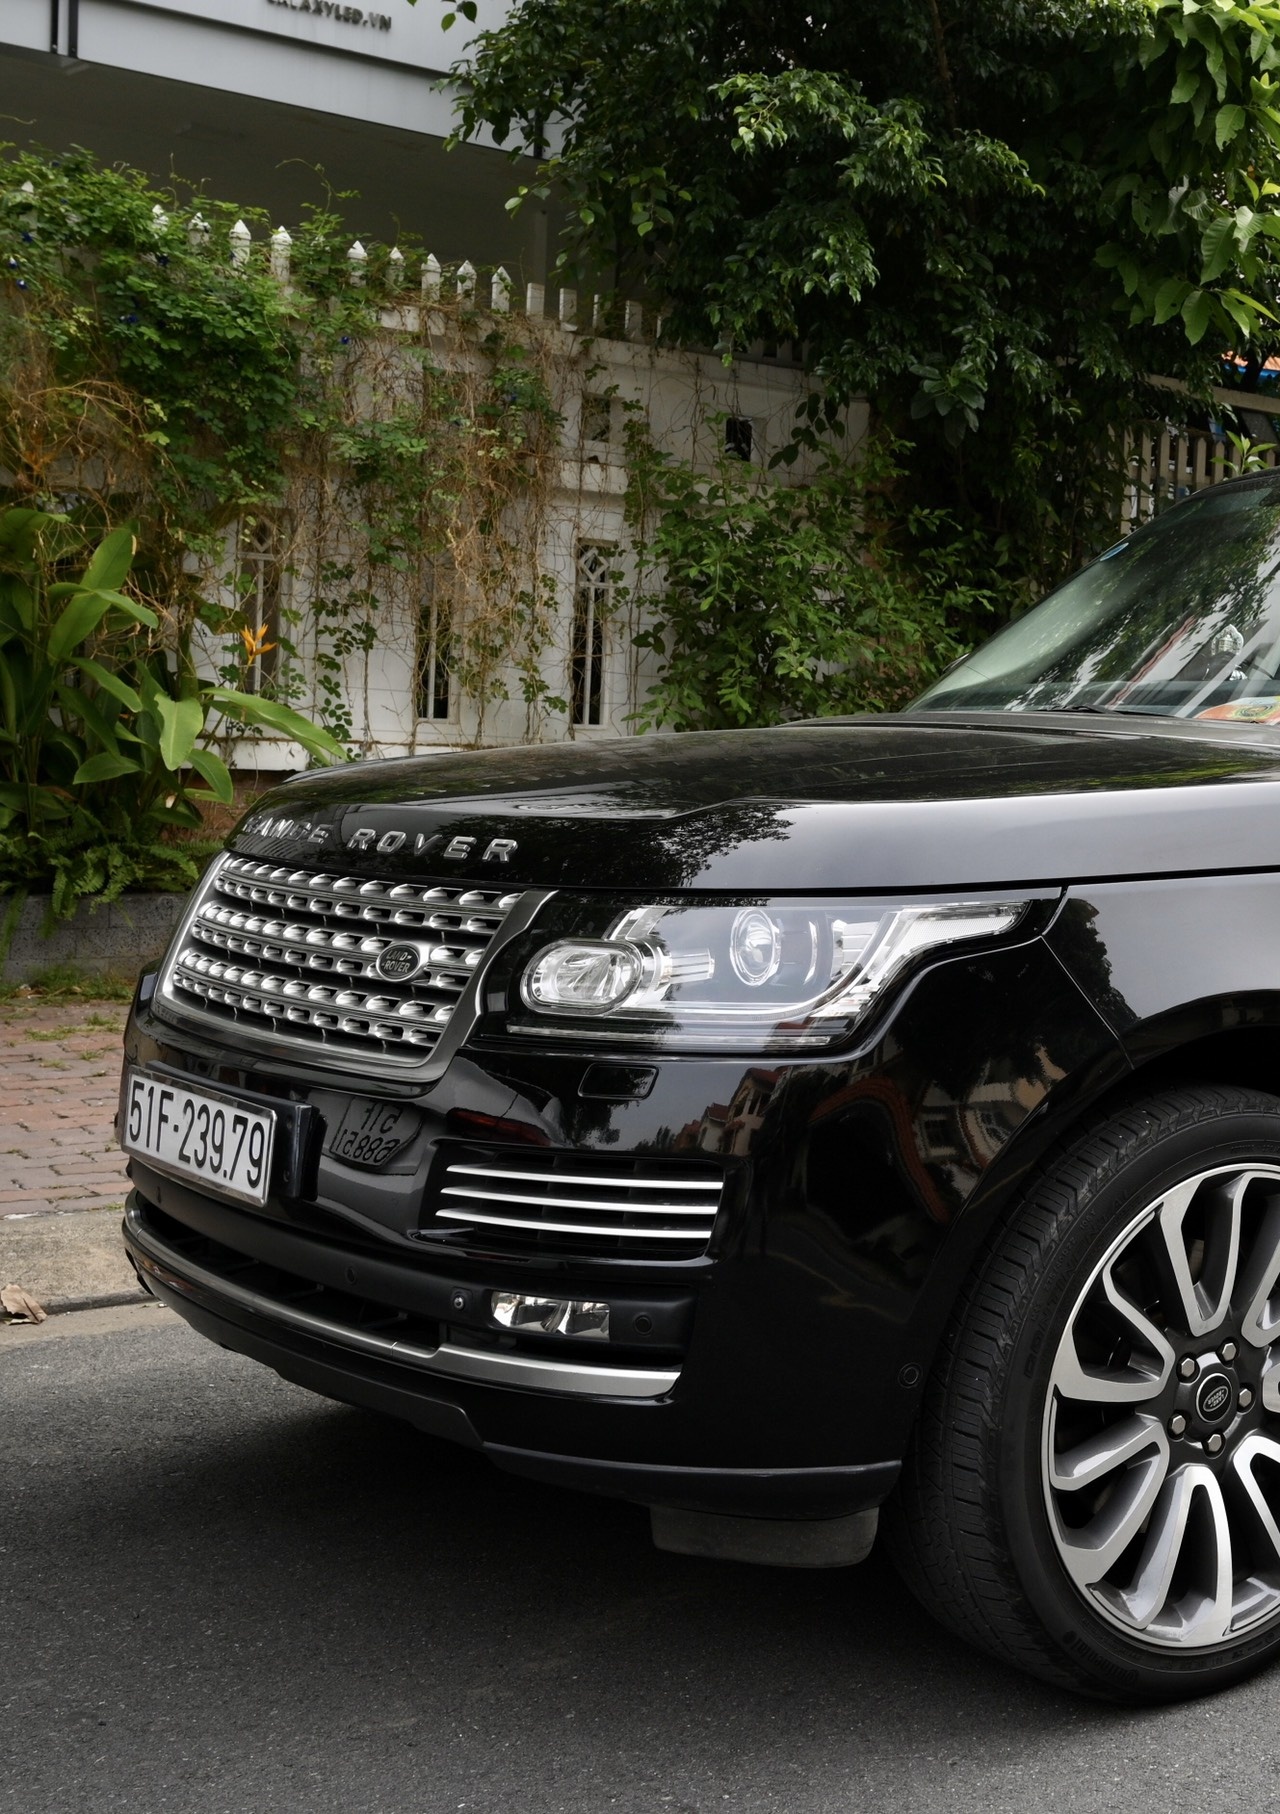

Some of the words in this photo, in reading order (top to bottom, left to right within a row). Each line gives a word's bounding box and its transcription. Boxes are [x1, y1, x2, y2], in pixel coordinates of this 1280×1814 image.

[265, 0, 392, 31] LAXYLED.VN
[242, 815, 334, 845] RANGE
[347, 828, 519, 863] ROVER
[128, 1079, 266, 1189] 51F-239.79
